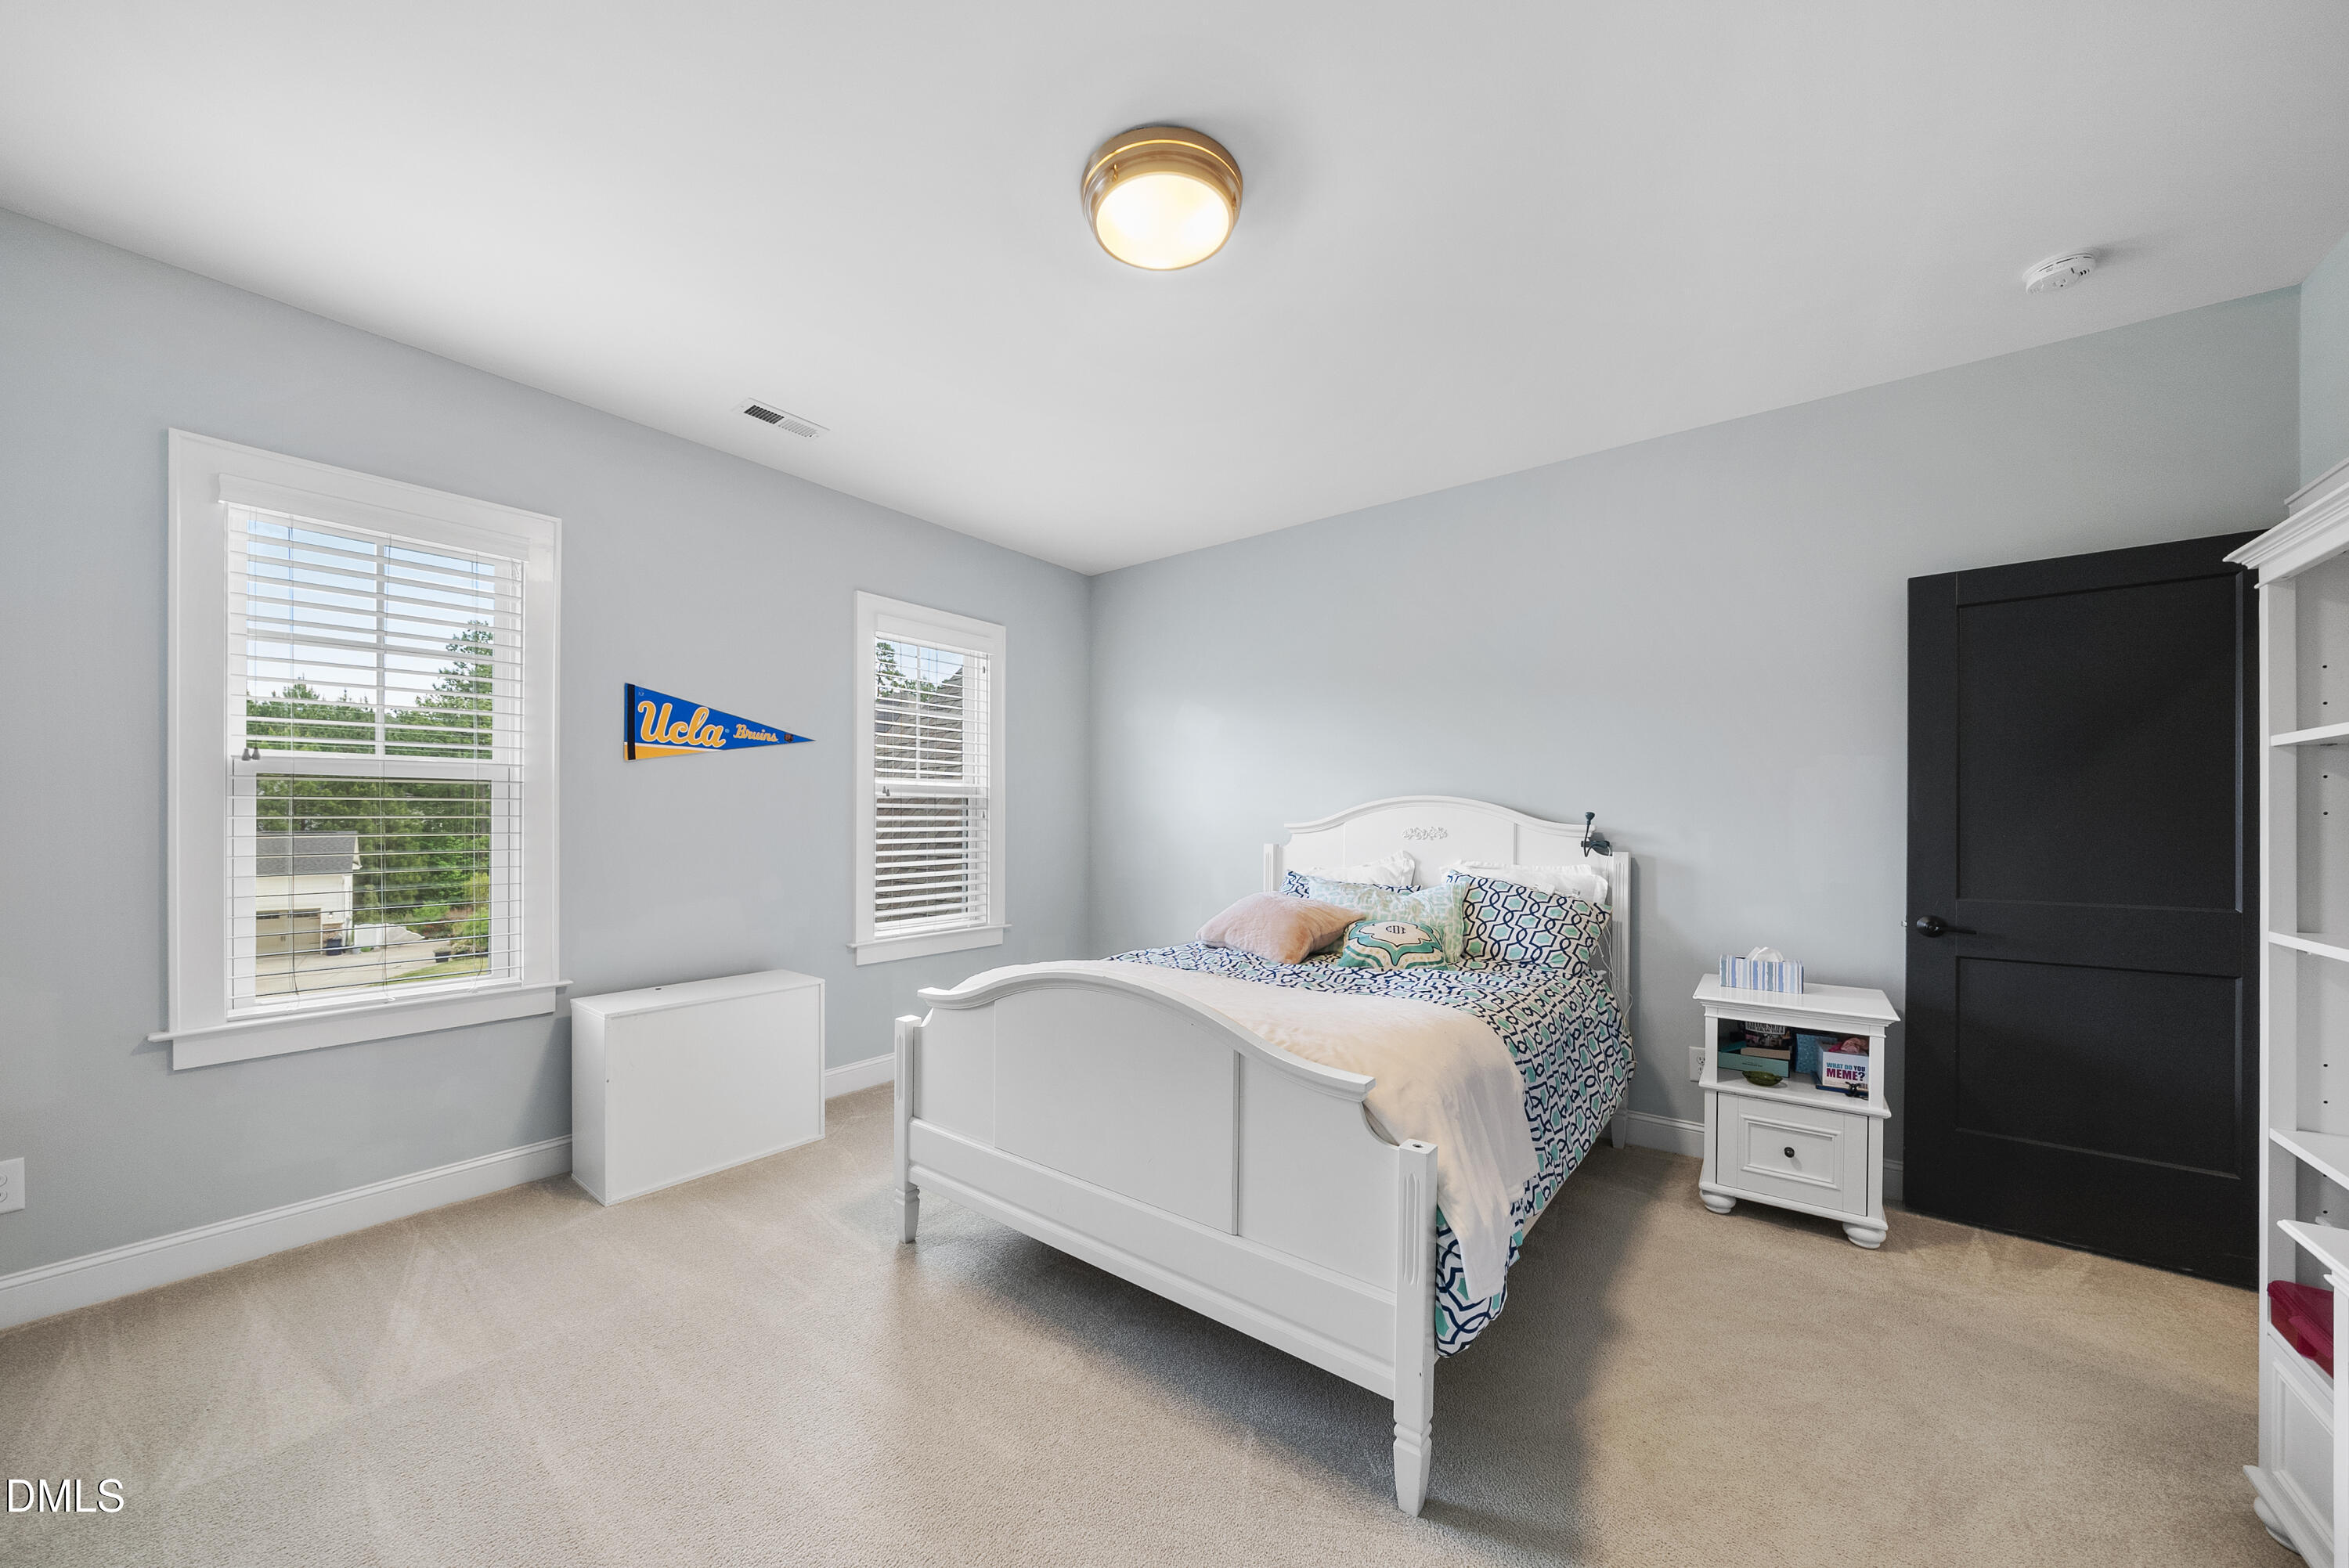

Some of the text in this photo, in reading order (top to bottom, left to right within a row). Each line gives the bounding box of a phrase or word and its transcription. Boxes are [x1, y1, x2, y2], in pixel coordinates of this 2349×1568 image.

[637, 701, 778, 748] Ucla Bruins
[1826, 1068, 1866, 1081] MEME?
